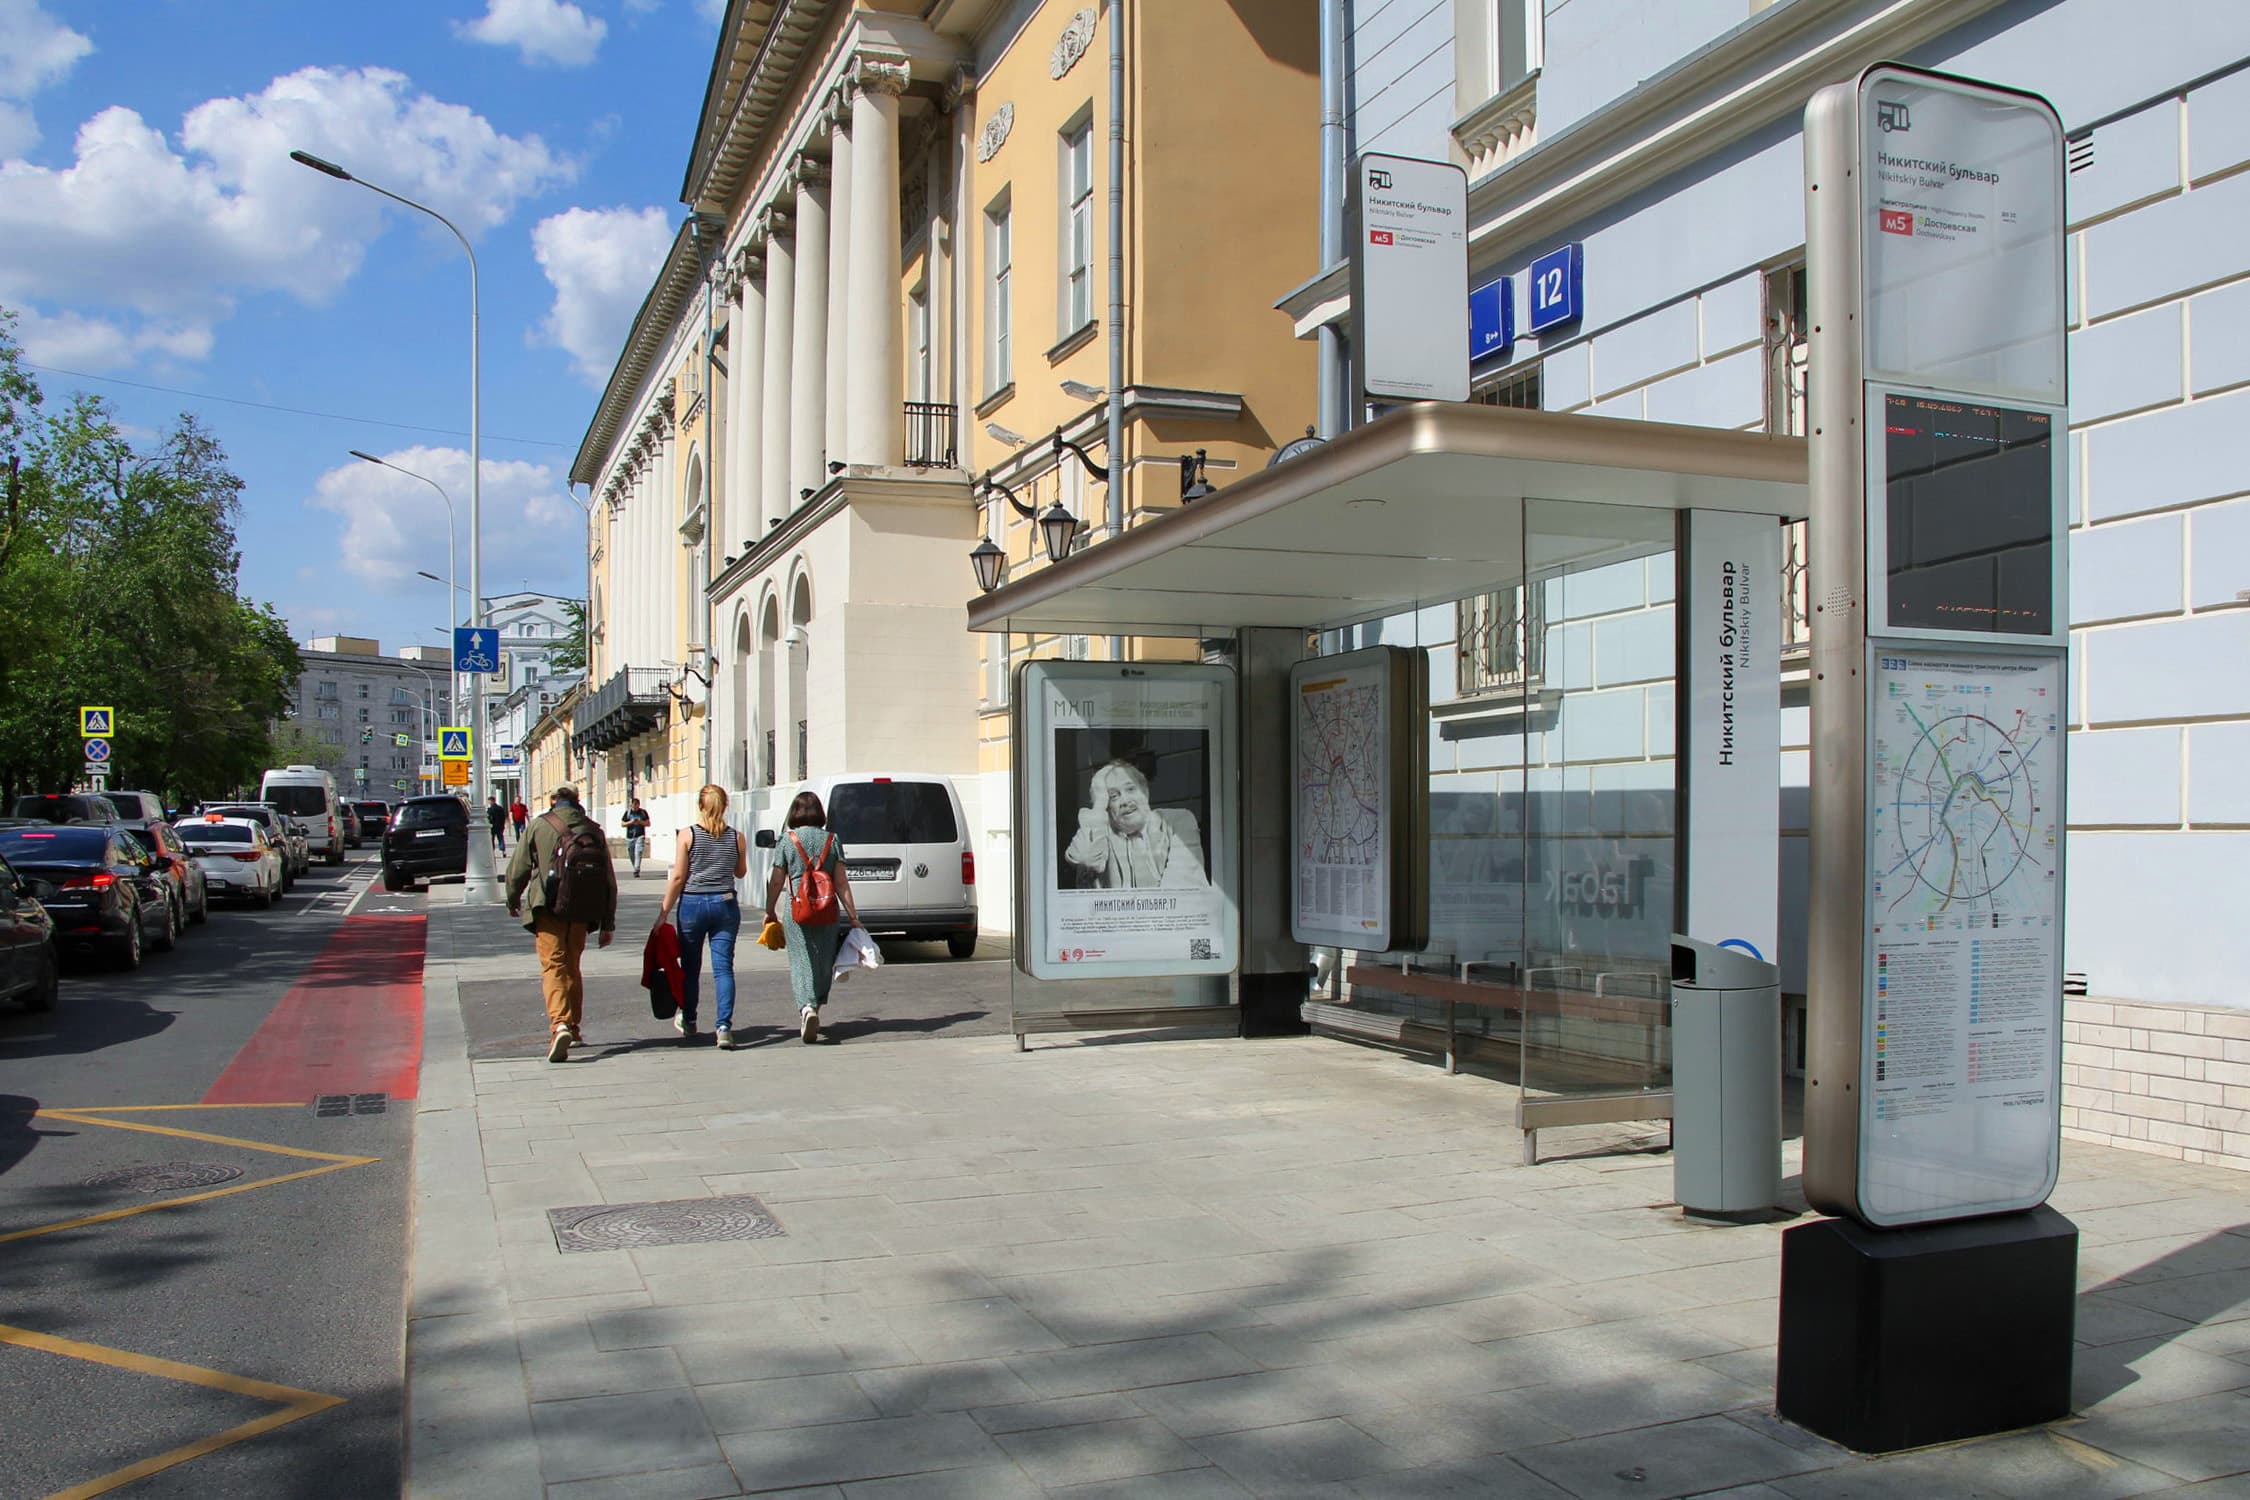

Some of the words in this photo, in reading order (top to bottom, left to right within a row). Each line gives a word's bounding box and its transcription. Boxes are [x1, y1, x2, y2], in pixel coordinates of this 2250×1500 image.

[1878, 152, 1946, 174] Никитский
[1949, 163, 1999, 185] бульвар
[1878, 170, 1917, 187] Nikitskiy
[1369, 196, 1415, 210] Никитский
[1417, 202, 1451, 216] бульвар
[1924, 217, 1976, 233] Достоевская
[1537, 268, 1563, 310] 12
[1739, 562, 1751, 605] Bulvar
[1719, 560, 1737, 647] бульвар
[1740, 609, 1752, 668] Nikitskiy
[1719, 655, 1734, 766] Никитский
[1094, 898, 1135, 912] НИКИТСКИЙ
[1169, 898, 1177, 910] 17
